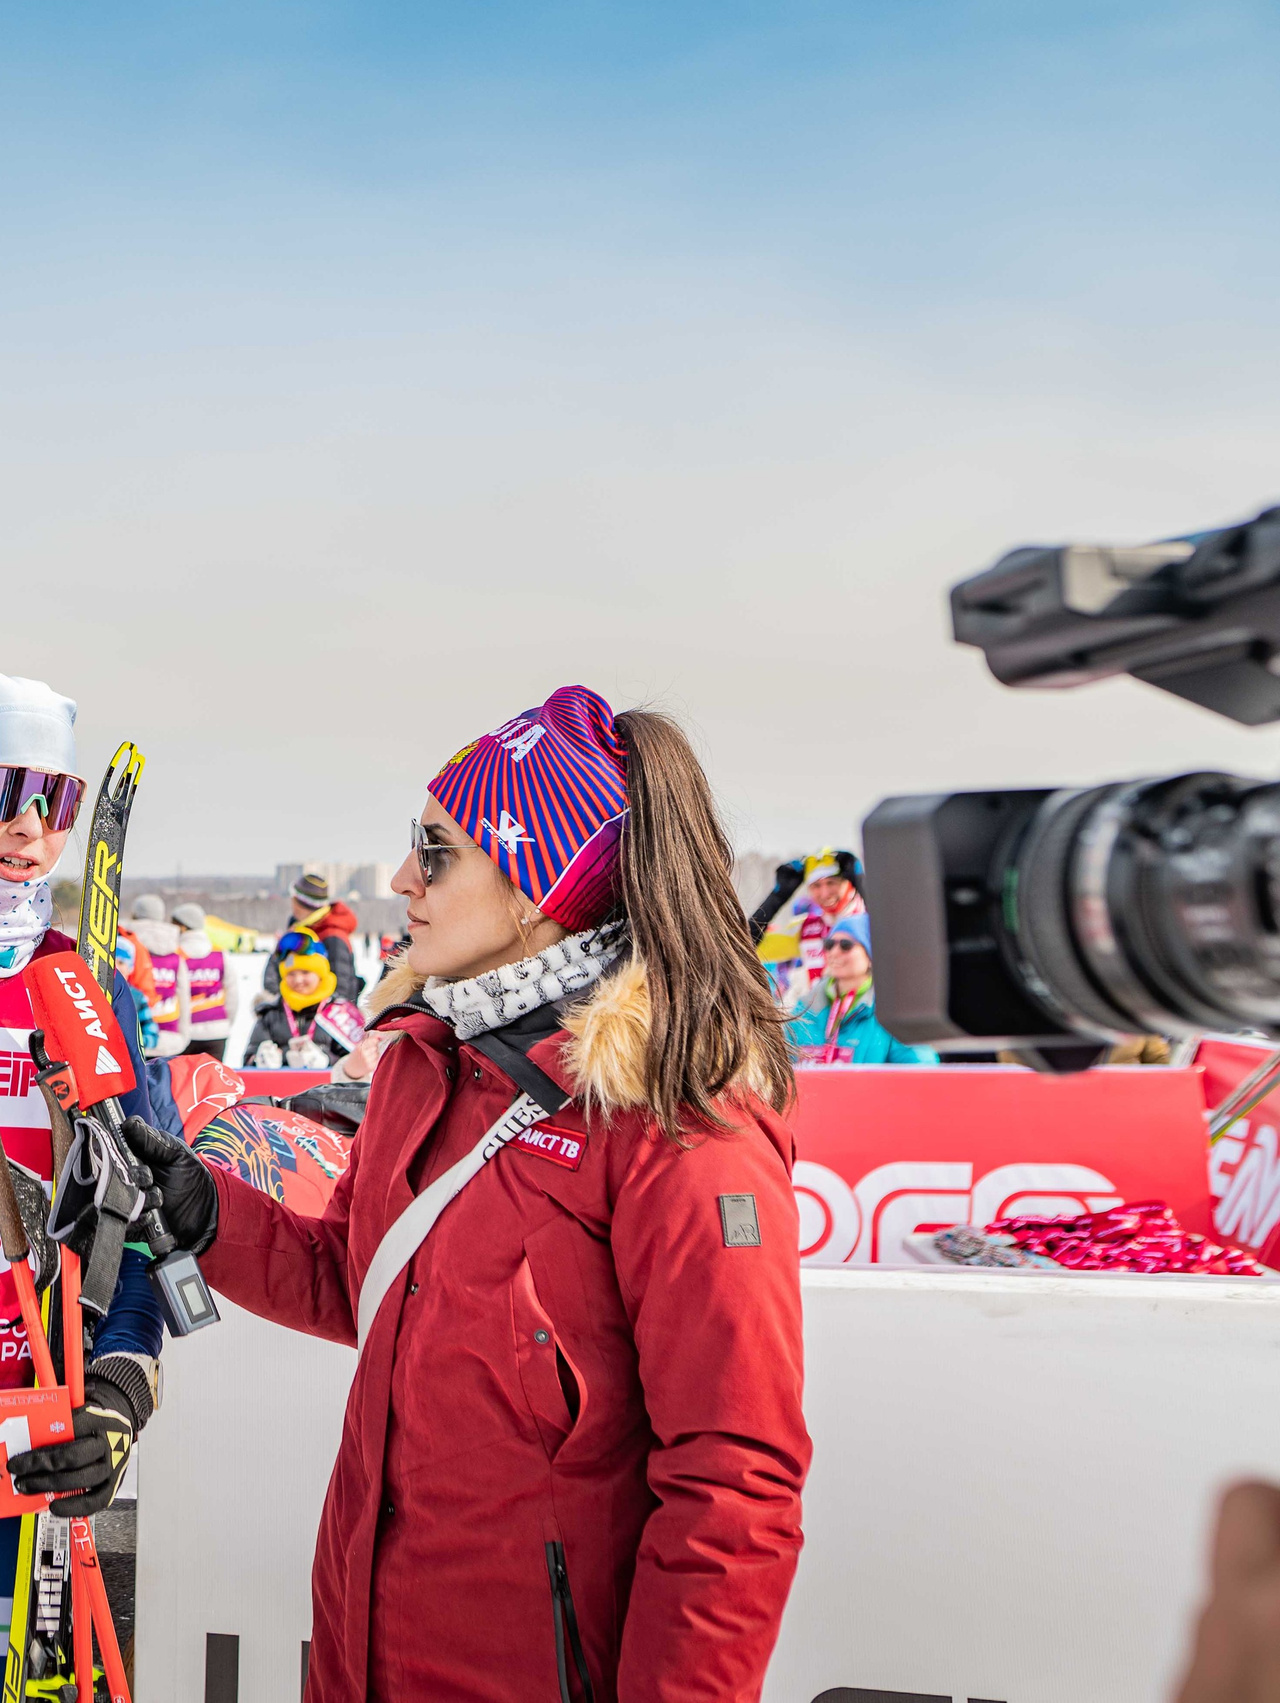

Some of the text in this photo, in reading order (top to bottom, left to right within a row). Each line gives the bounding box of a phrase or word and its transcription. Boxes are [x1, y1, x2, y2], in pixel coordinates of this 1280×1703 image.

[53, 967, 109, 1041] АИСТ
[518, 1127, 580, 1159] АИСТ ТВ
